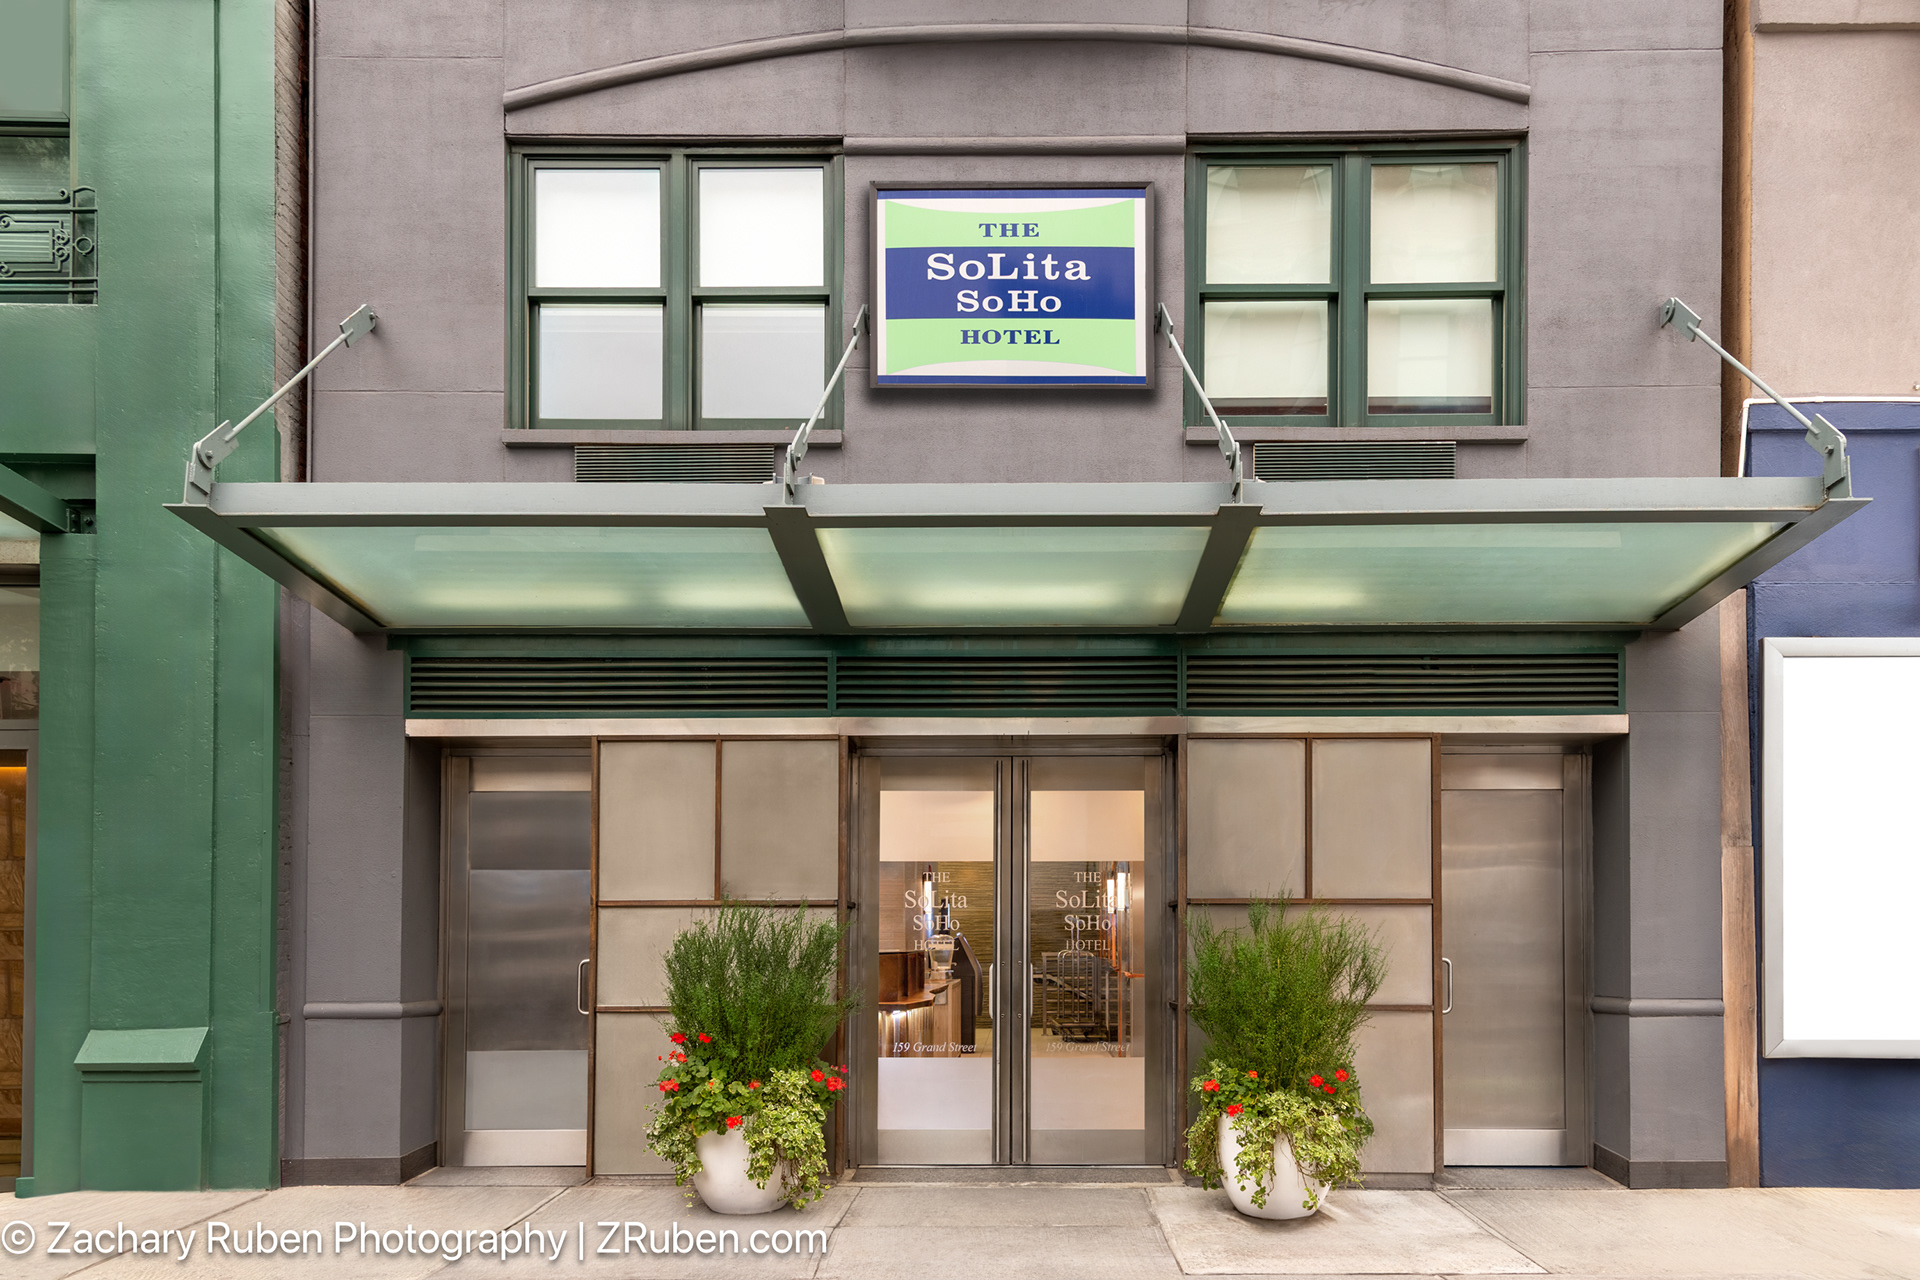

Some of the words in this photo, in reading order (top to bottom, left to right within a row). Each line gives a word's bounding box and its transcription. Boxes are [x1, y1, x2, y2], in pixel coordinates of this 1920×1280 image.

[978, 222, 1040, 238] THE
[926, 252, 1092, 281] SoLita
[956, 289, 1062, 313] SoHo
[959, 329, 1060, 345] HOTEL
[922, 871, 951, 883] THE
[1073, 871, 1102, 883] THE
[904, 889, 968, 909] SoLita
[1055, 889, 1119, 909] SoLita
[913, 914, 960, 931] SoHo
[1064, 914, 1111, 931] SoHo
[1065, 939, 1111, 951] HOTEL
[892, 1041, 911, 1053] 159
[912, 1041, 947, 1053] Grand
[947, 1041, 978, 1053] Street
[1046, 1041, 1063, 1053] 159
[1065, 1041, 1100, 1053] Grand
[1100, 1041, 1131, 1053] Street
